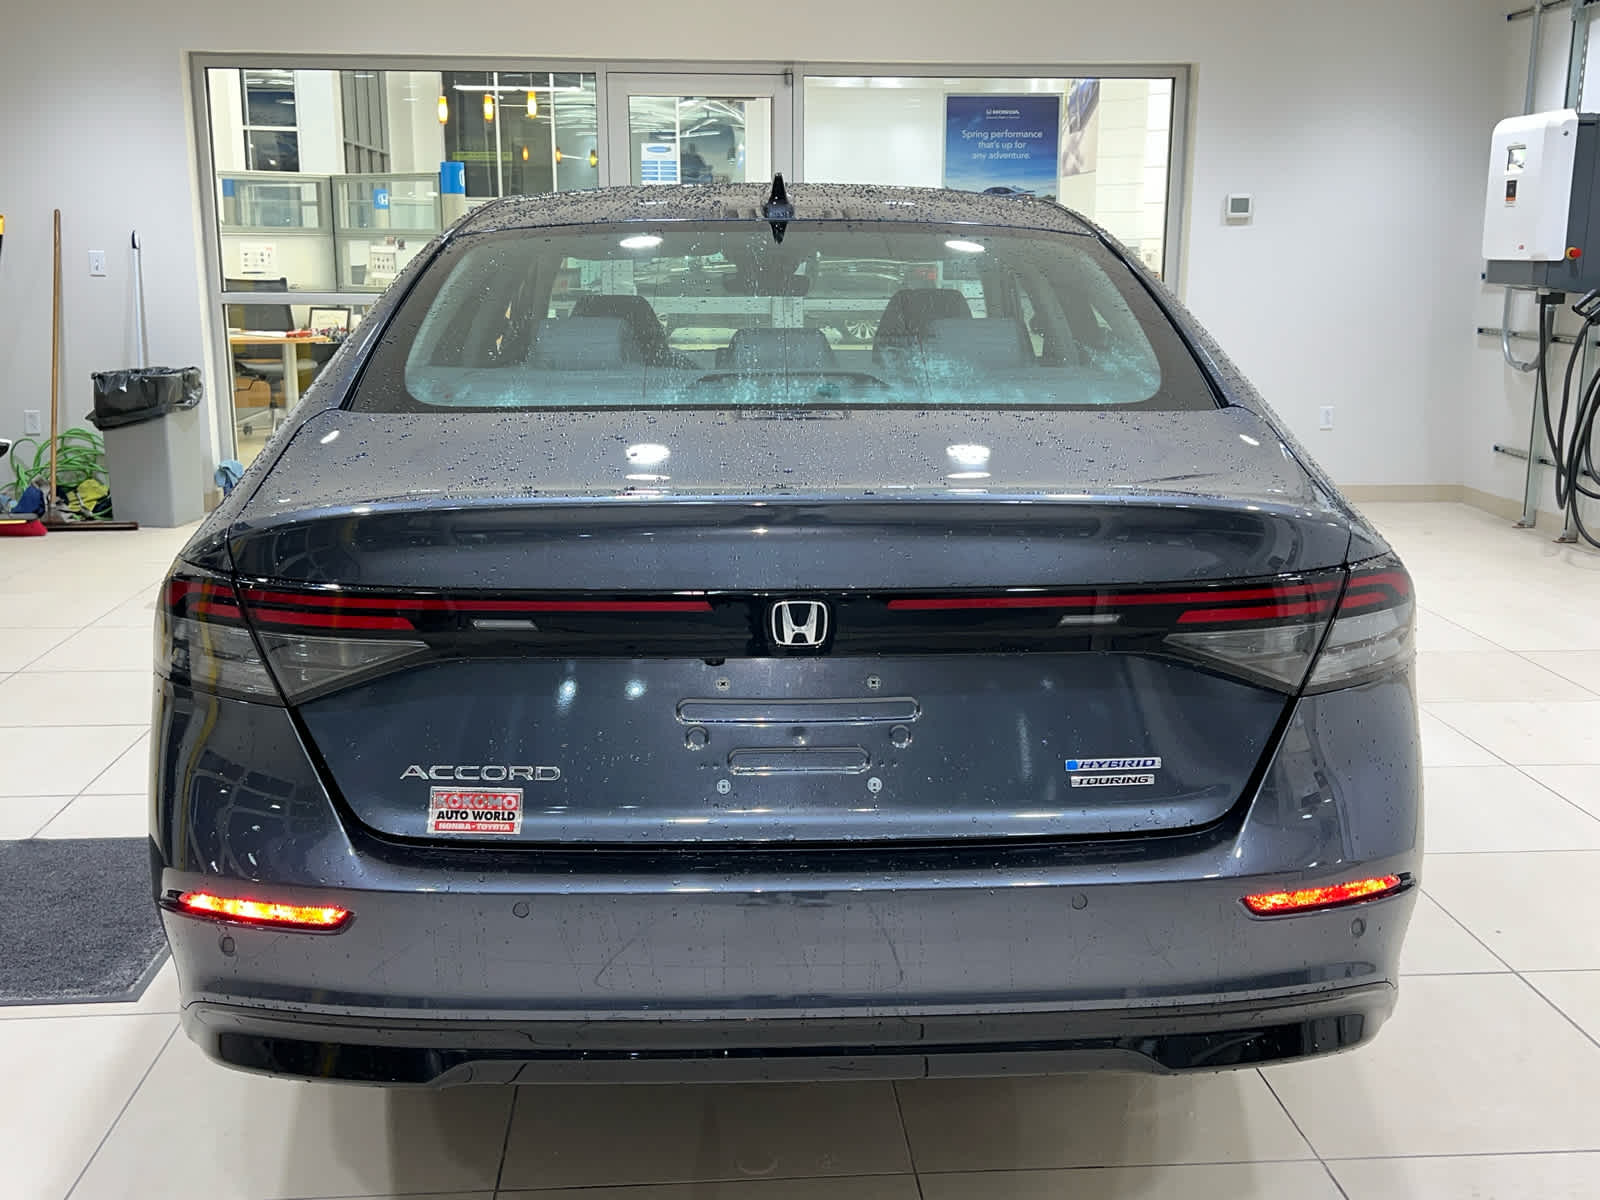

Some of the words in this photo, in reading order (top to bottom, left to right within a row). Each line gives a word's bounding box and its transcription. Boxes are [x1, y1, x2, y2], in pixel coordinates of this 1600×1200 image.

[961, 129, 989, 140] Spring
[990, 128, 1043, 140] performance
[978, 140, 1000, 149] that's
[1001, 142, 1013, 151] up
[1015, 140, 1026, 149] for
[971, 152, 987, 161] any
[988, 151, 1031, 160] adventure.
[1080, 759, 1156, 769] HYBRID
[400, 765, 561, 781] ACCORD
[1079, 776, 1149, 786] TOURING
[436, 794, 517, 810] KOKOMO
[436, 810, 469, 820] AUTO
[472, 811, 516, 821] WORLD
